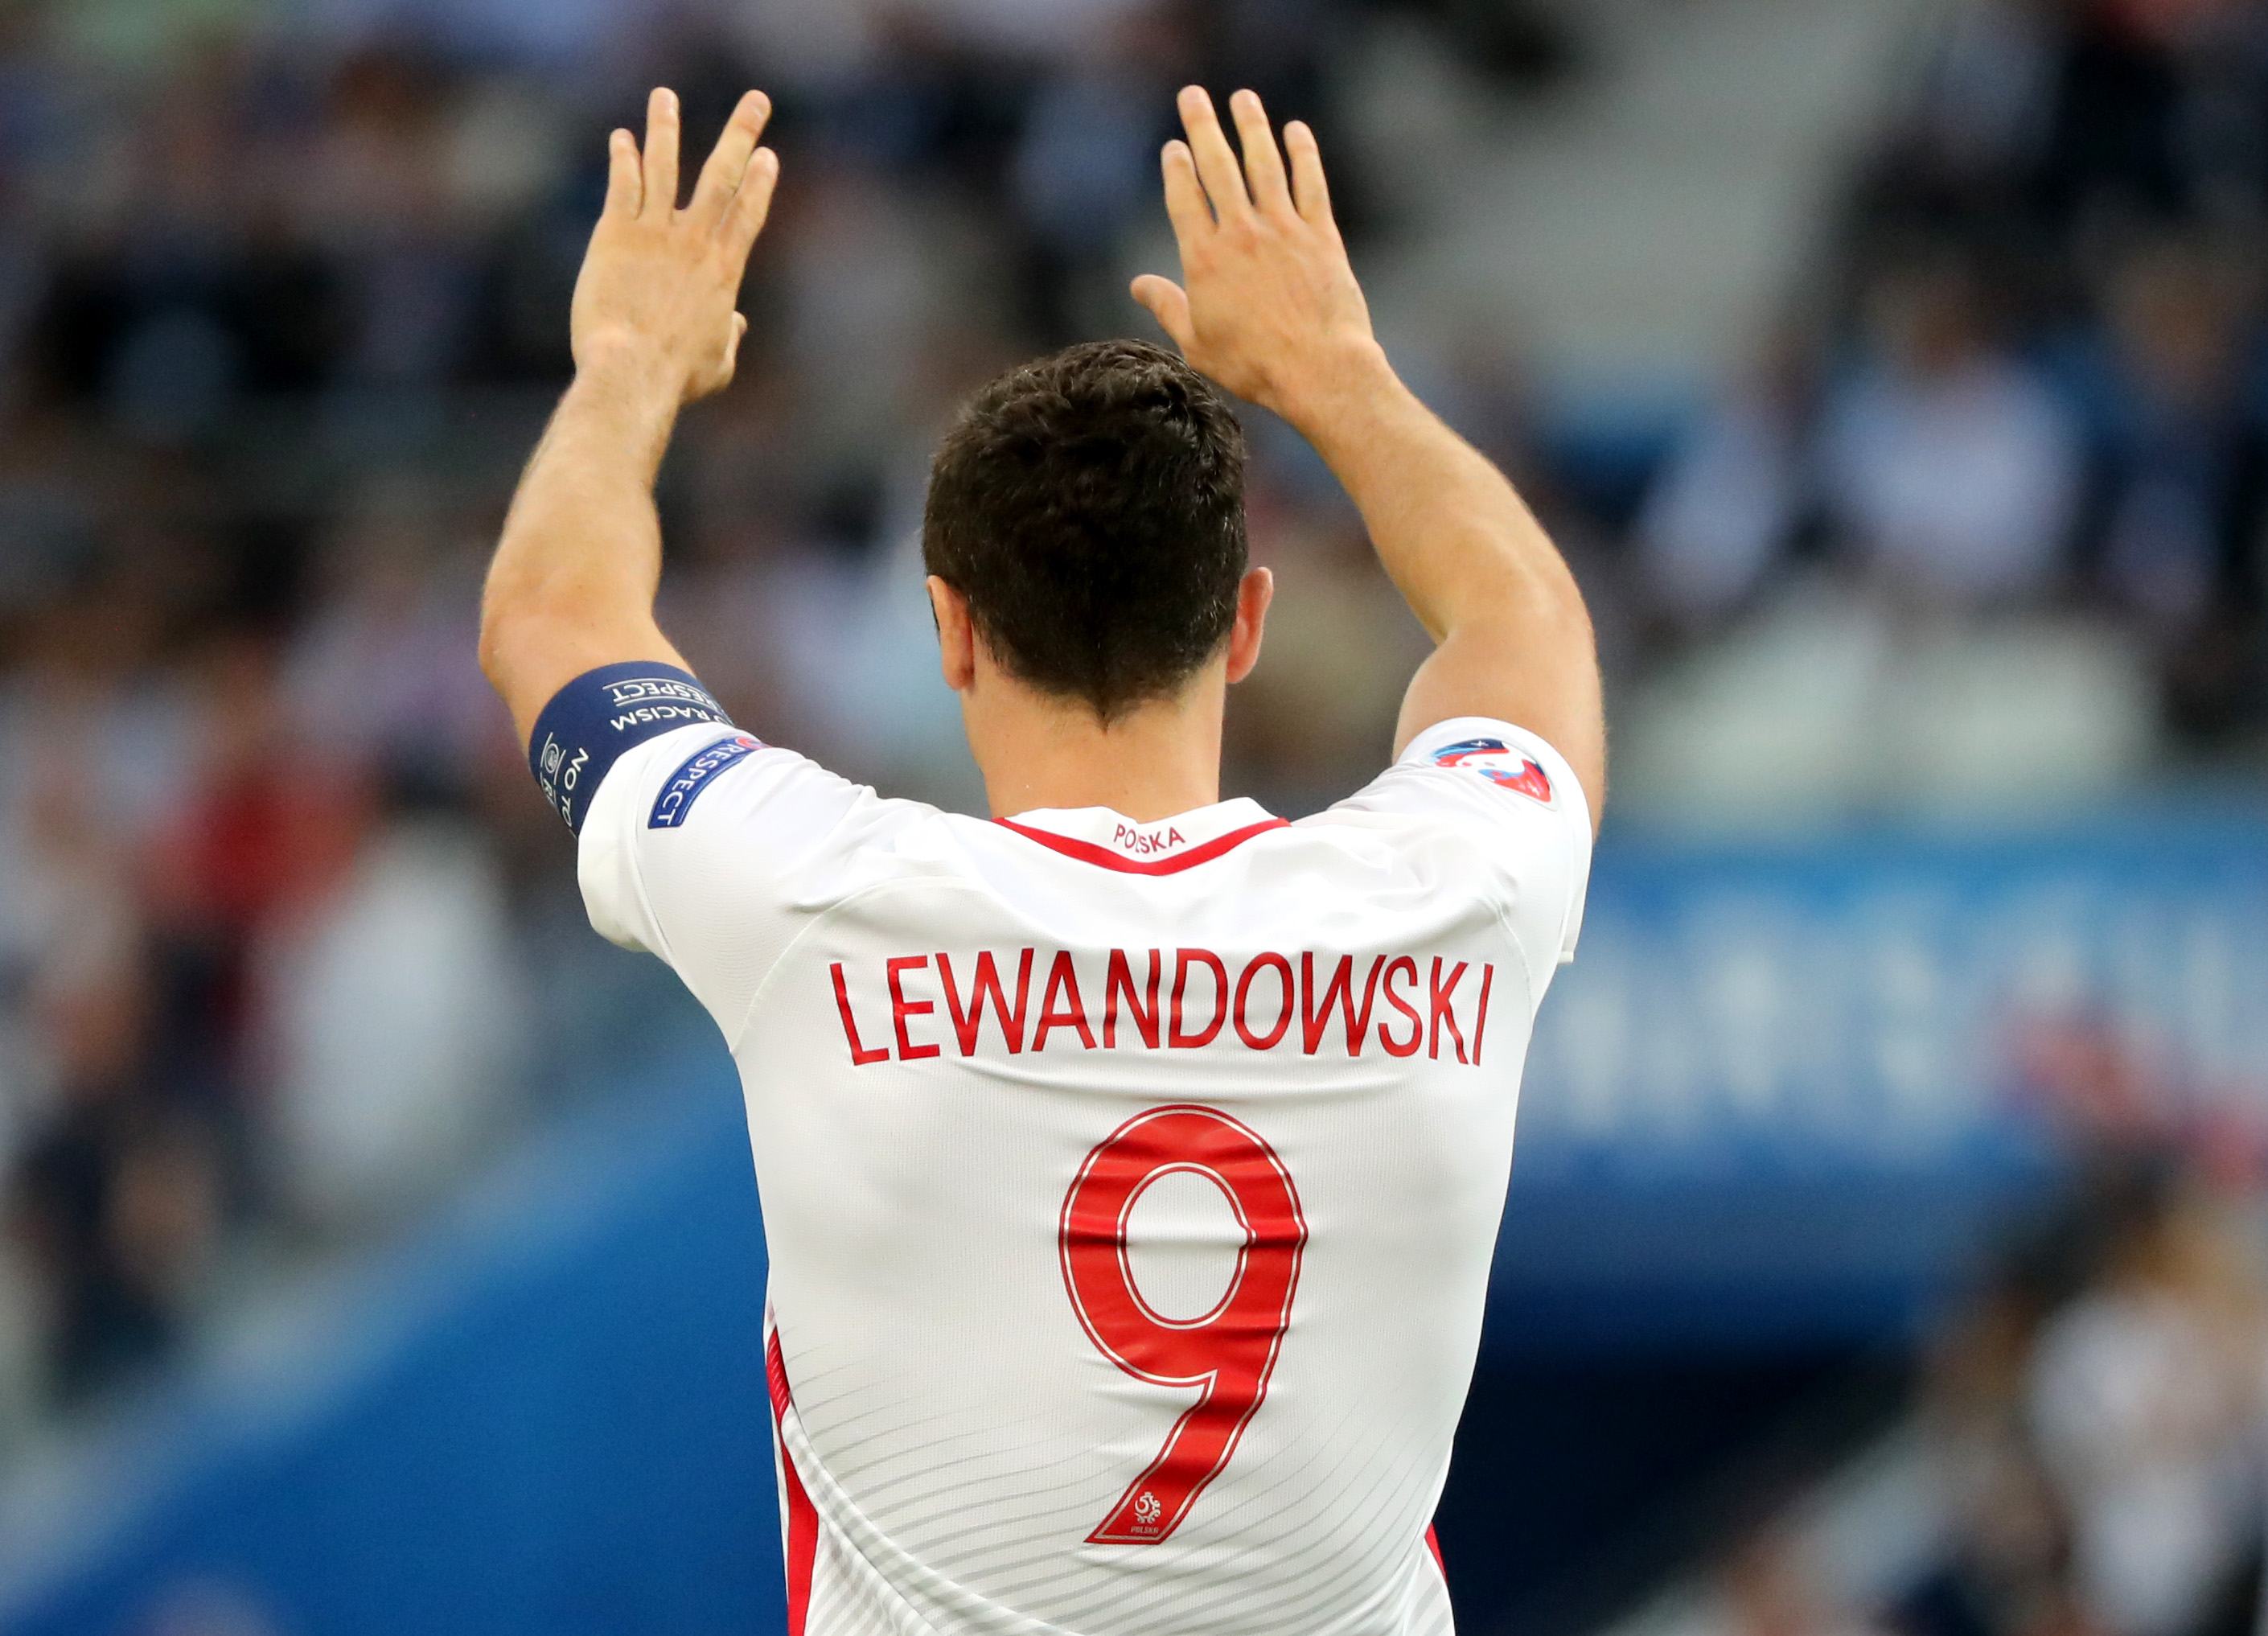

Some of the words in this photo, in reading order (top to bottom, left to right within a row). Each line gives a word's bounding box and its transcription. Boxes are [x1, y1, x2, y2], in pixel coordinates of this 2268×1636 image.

[611, 681, 717, 711] RESPECT
[610, 705, 711, 731] RACISM
[564, 746, 589, 790] NO
[656, 743, 746, 825] RESPECT
[561, 795, 572, 827] TO
[829, 947, 1494, 1067] LEWANDOWSKI
[1058, 1104, 1309, 1545] 9
[1130, 1526, 1159, 1534] POLSKA
